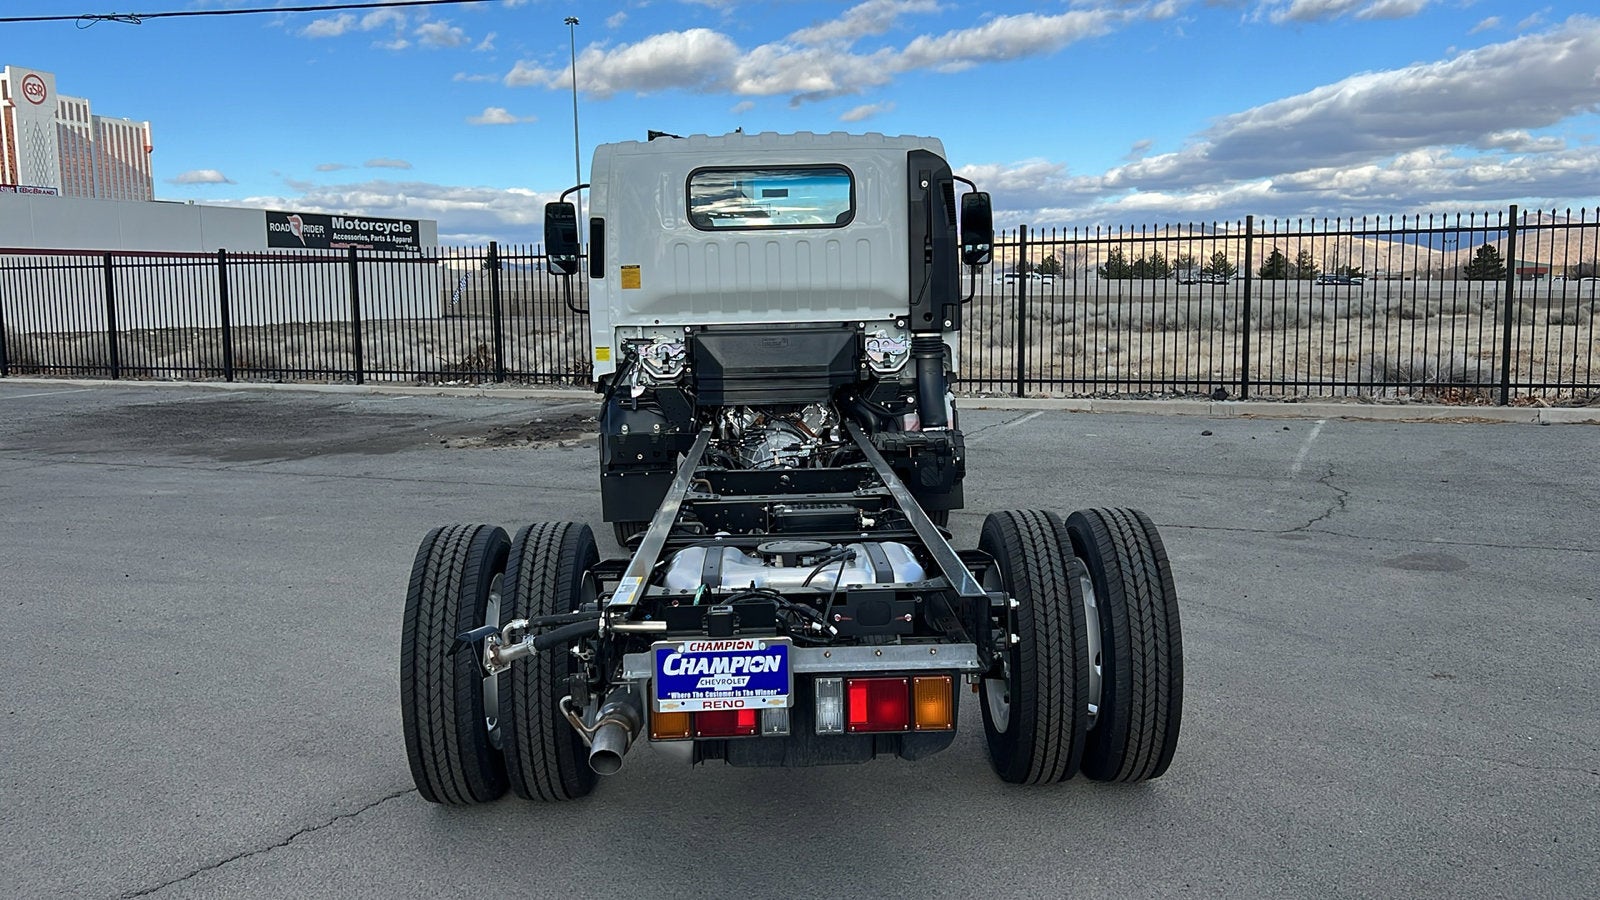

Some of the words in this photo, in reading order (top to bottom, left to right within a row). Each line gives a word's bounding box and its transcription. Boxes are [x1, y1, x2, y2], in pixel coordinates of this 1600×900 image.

[25, 82, 43, 97] GSR
[269, 222, 291, 232] ROAD
[303, 224, 325, 234] RIDER
[331, 216, 412, 234] Motorcycle
[332, 232, 370, 242] Accessories,
[370, 234, 386, 242] Parts
[392, 235, 413, 244] Apparel
[689, 641, 754, 652] CHAMPION
[663, 653, 781, 676] CHAMPION
[700, 678, 746, 686] CHEVROLET
[692, 691, 704, 699] The
[705, 690, 734, 698] Customer
[742, 689, 754, 697] The
[702, 700, 745, 709] RENO
